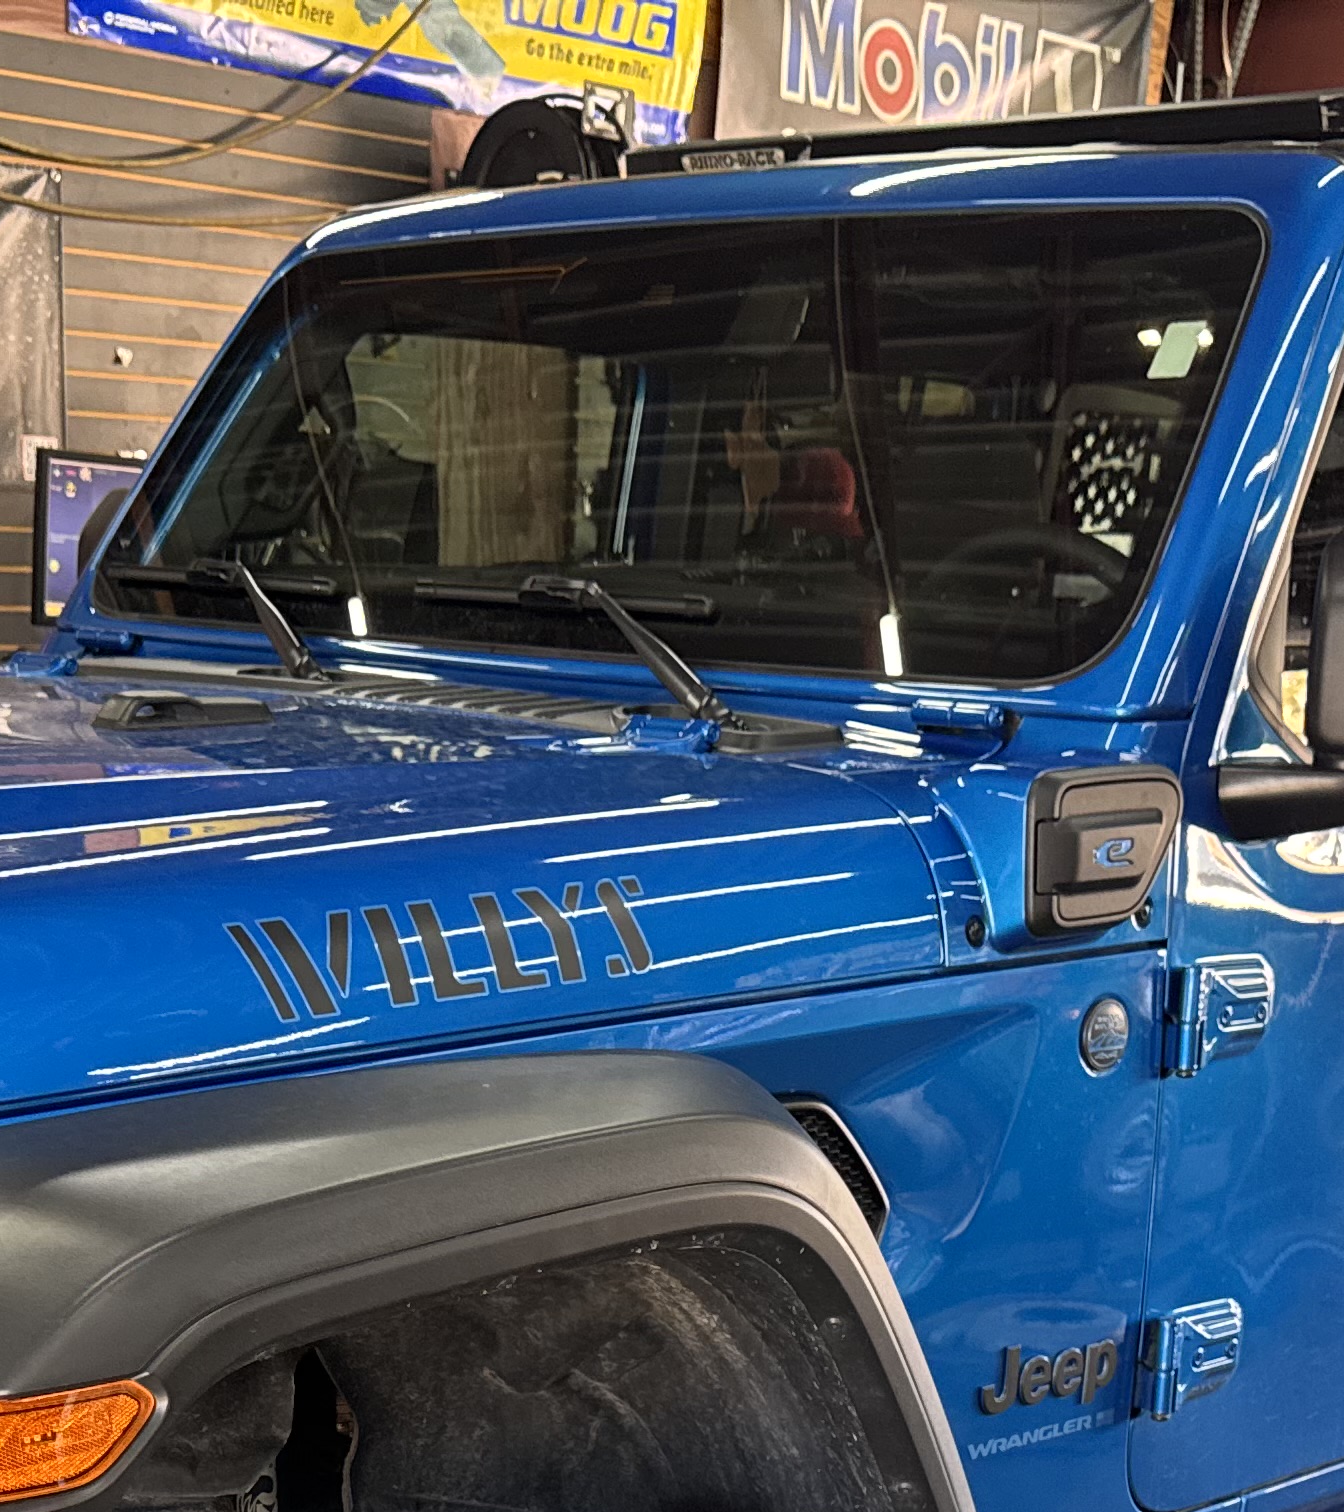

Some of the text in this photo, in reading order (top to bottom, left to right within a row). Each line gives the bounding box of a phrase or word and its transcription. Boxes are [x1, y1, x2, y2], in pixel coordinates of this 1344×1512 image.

[299, 2, 335, 25] here
[509, 0, 673, 51] MOOG
[525, 38, 544, 57] Go
[549, 43, 574, 64] the
[577, 52, 615, 73] extra
[780, 0, 1024, 124] Mobil
[224, 875, 654, 1022] WILLYS
[980, 1338, 1118, 1415] Jeep
[968, 1414, 1093, 1460] WRANGLER
